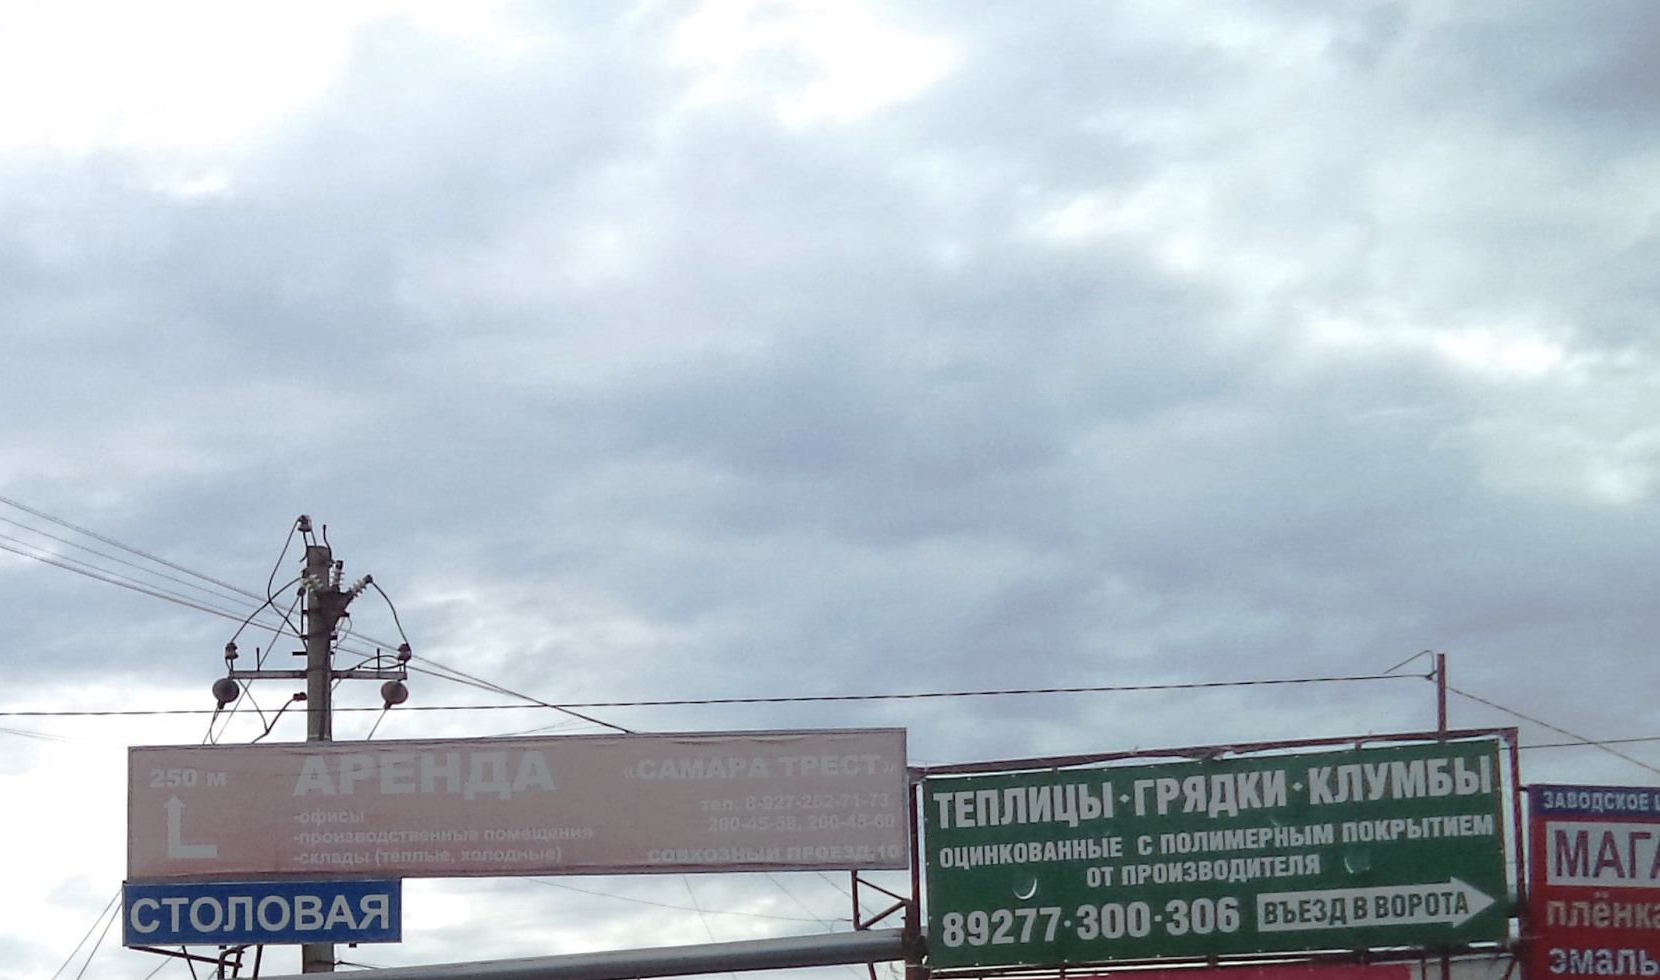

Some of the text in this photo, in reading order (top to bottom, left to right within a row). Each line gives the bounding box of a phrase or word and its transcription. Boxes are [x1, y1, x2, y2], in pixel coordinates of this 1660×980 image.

[149, 767, 198, 788] 250
[293, 751, 556, 800] АРЕНДА
[933, 755, 1491, 829] ТЕПЛИЦЫ ГРЯДКИ КЛУМБЫ
[1543, 790, 1649, 813] ЗАВОДСКОЕ
[484, 826, 594, 842] помещения
[940, 814, 1494, 870] ОЦИНКОВАННЫЕ С ПОЛИМЕРНЫМ ПОКРЫТИЕМ
[1086, 854, 1321, 888] ОТ ПРОИЗВОДИТЕЛЯ
[130, 894, 389, 934] СТОЛОВАЯ
[1264, 892, 1469, 926] ВЪЕЗД В ВОРОТА
